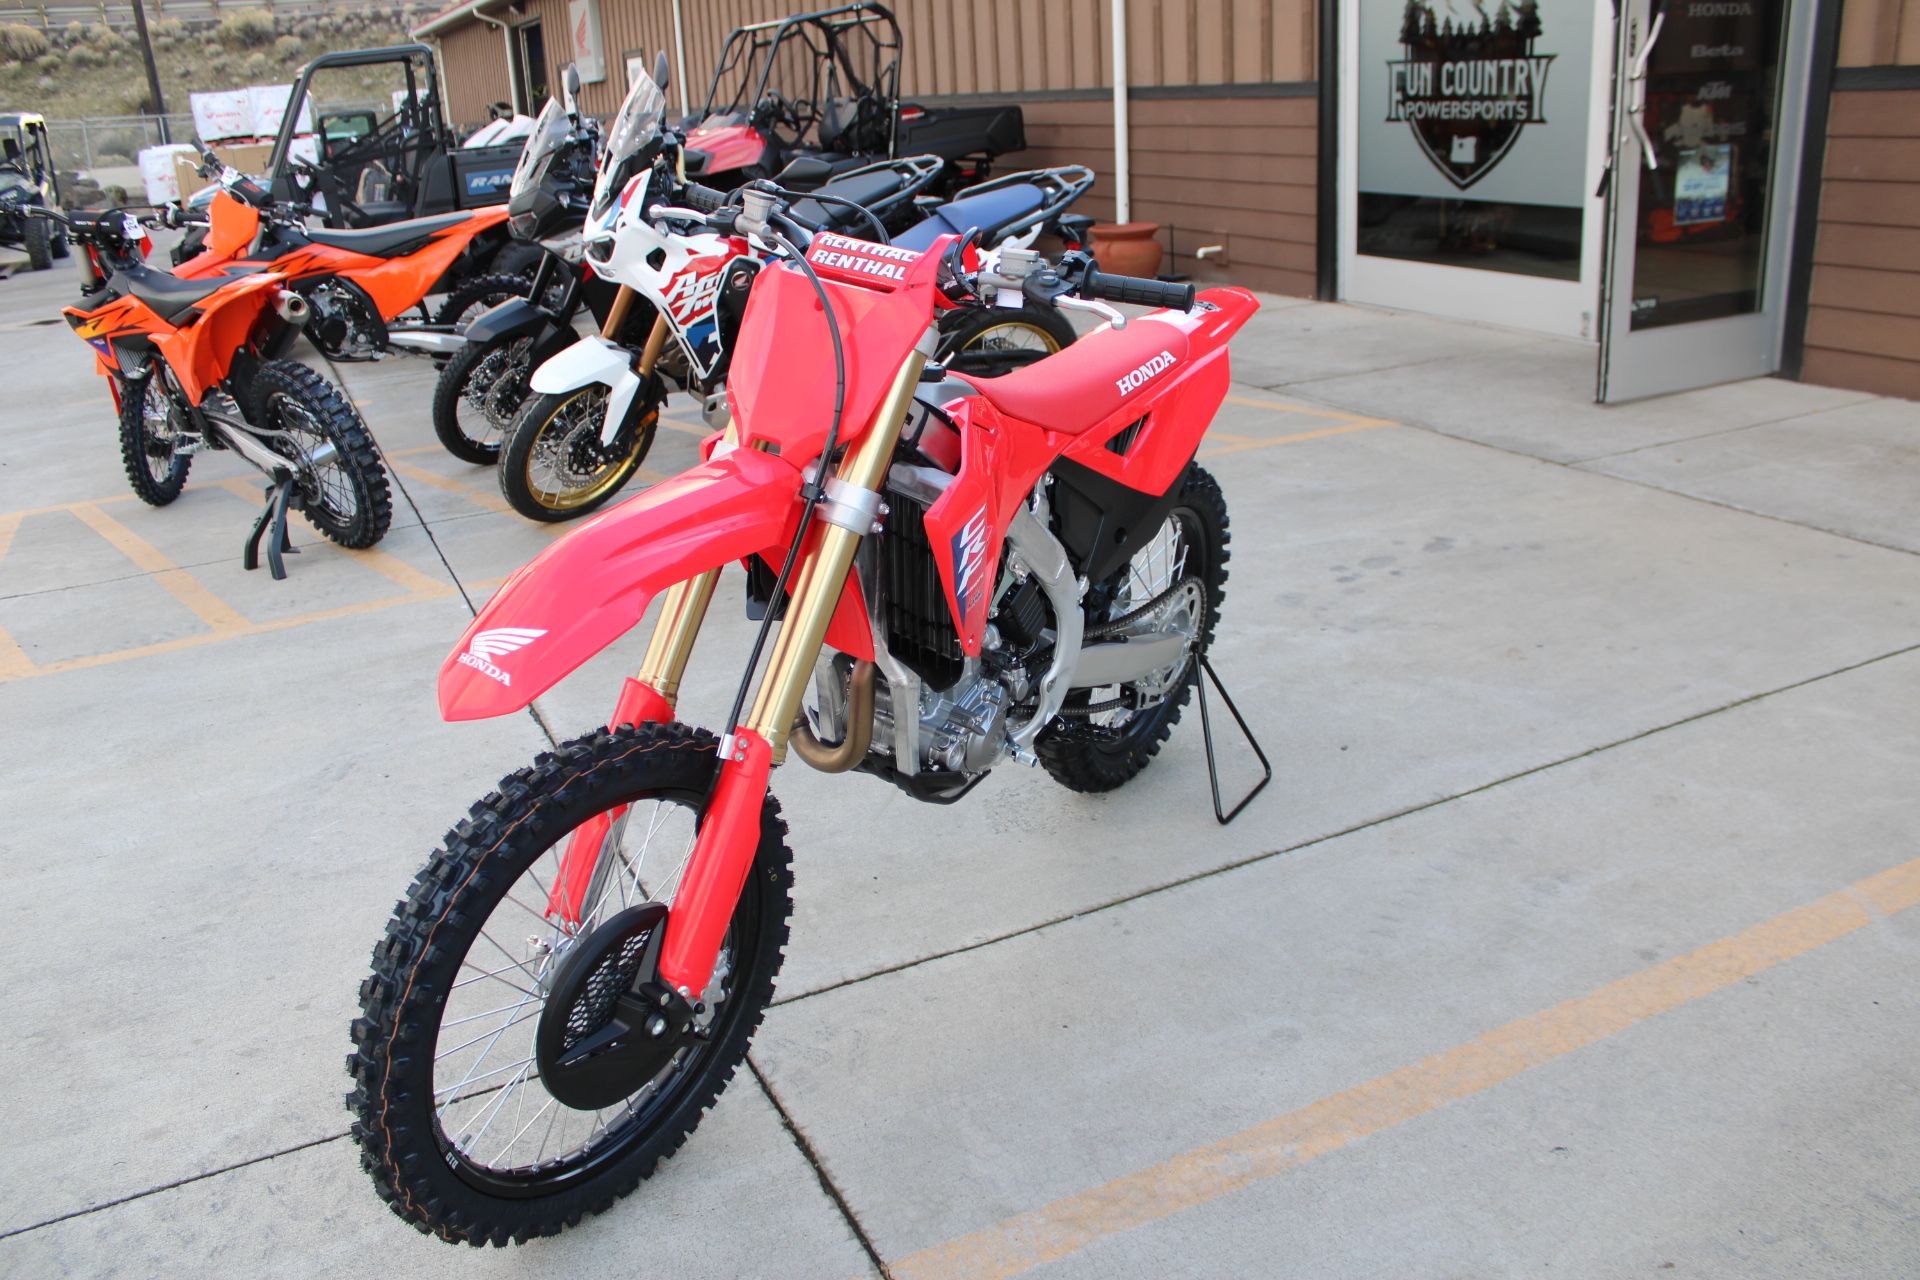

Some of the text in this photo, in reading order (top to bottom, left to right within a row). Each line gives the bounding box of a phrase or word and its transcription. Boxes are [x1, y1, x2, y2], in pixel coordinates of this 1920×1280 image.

[1687, 2, 1752, 17] HONDA
[1689, 43, 1744, 59] Beta
[1387, 56, 1553, 122] FUN COUNTRY
[1405, 100, 1528, 121] POWERSPORTS
[469, 173, 514, 189] RAN
[809, 248, 907, 281] RENTHAL
[1115, 350, 1177, 397] HONDA
[456, 652, 512, 687] HONDA
